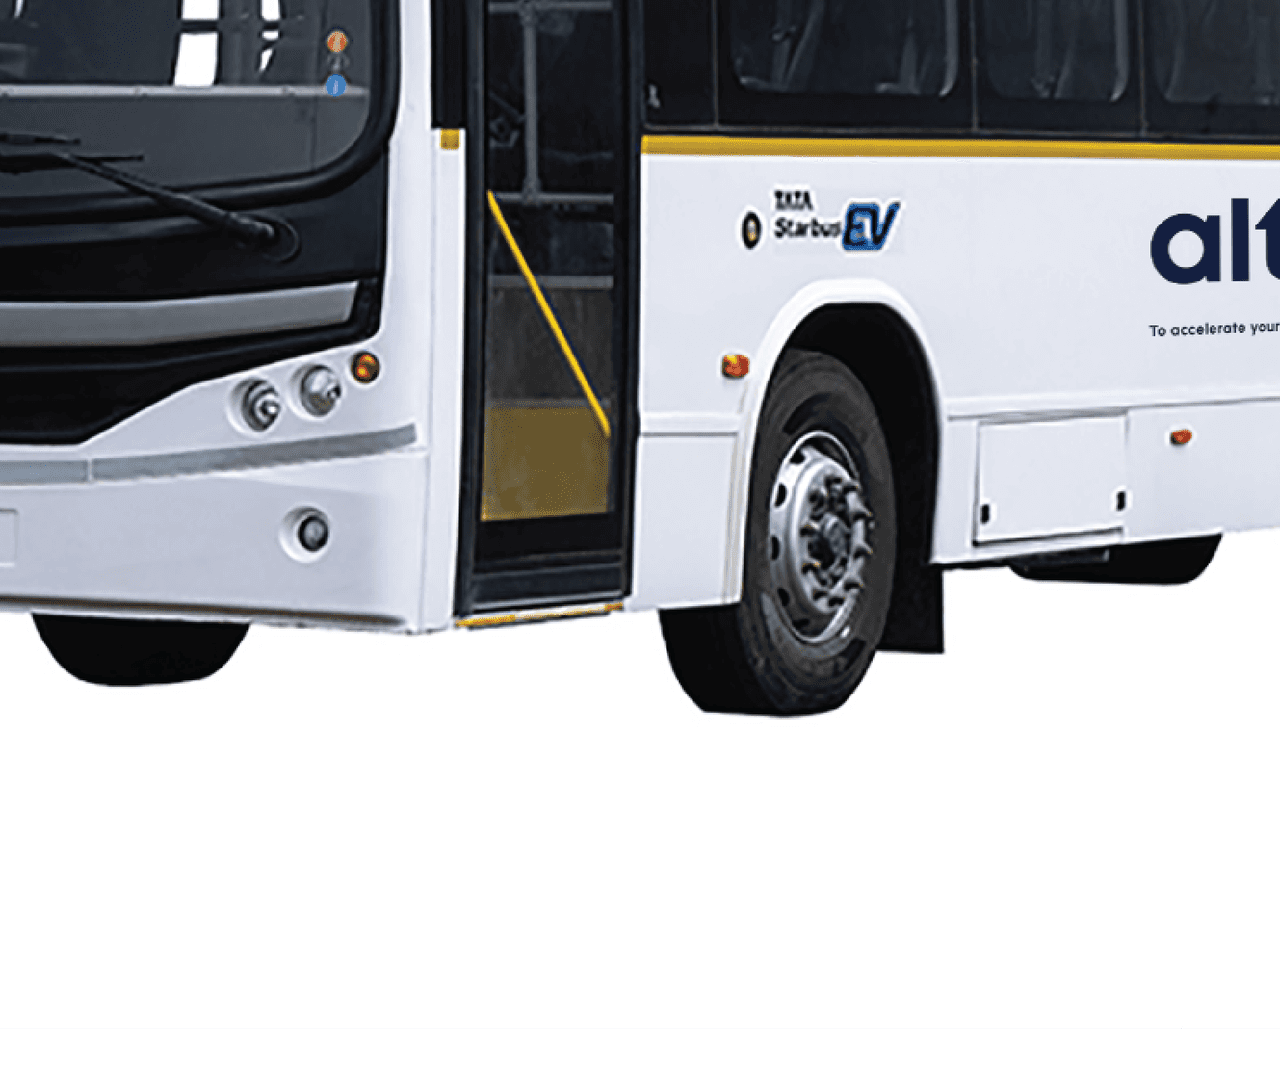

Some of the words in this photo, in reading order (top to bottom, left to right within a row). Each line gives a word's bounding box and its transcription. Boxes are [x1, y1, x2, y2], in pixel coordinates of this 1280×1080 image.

[773, 189, 814, 211] TATA
[773, 216, 842, 239] Starbus
[841, 200, 902, 252] EV
[1148, 324, 1167, 337] To
[1170, 321, 1246, 337] accelerate
